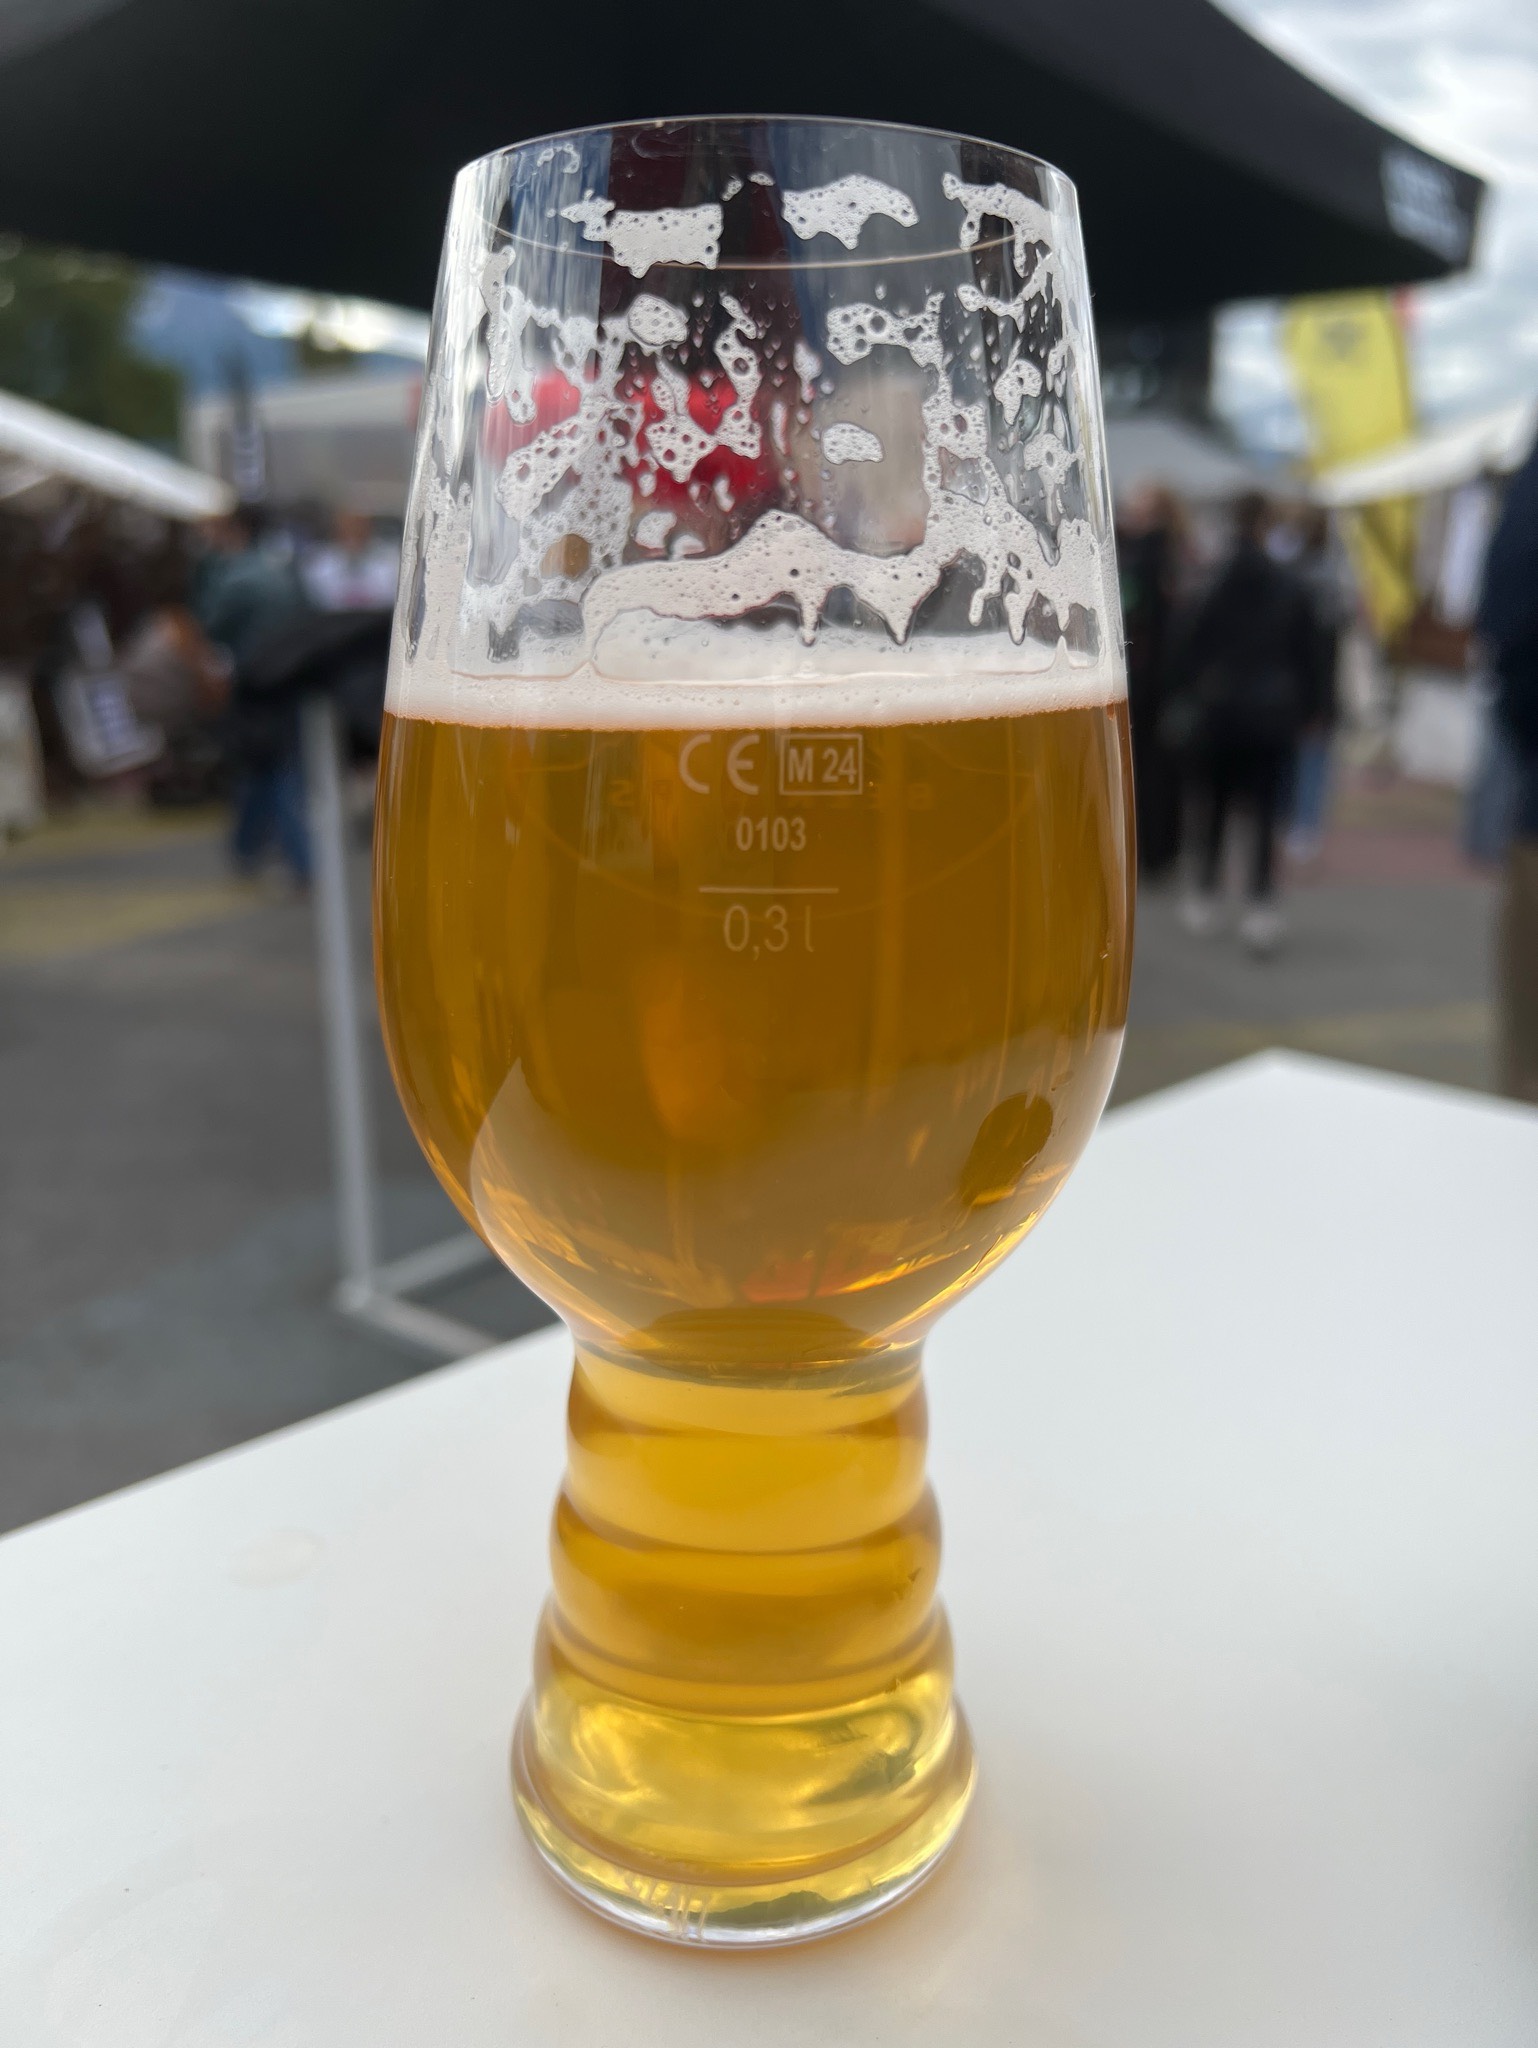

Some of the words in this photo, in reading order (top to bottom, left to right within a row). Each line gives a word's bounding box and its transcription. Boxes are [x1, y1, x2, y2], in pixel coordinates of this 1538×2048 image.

[678, 733, 761, 796] CE
[787, 747, 814, 784] M
[821, 746, 858, 785] 24
[735, 816, 807, 851] 0103
[723, 904, 790, 961] 0,3
